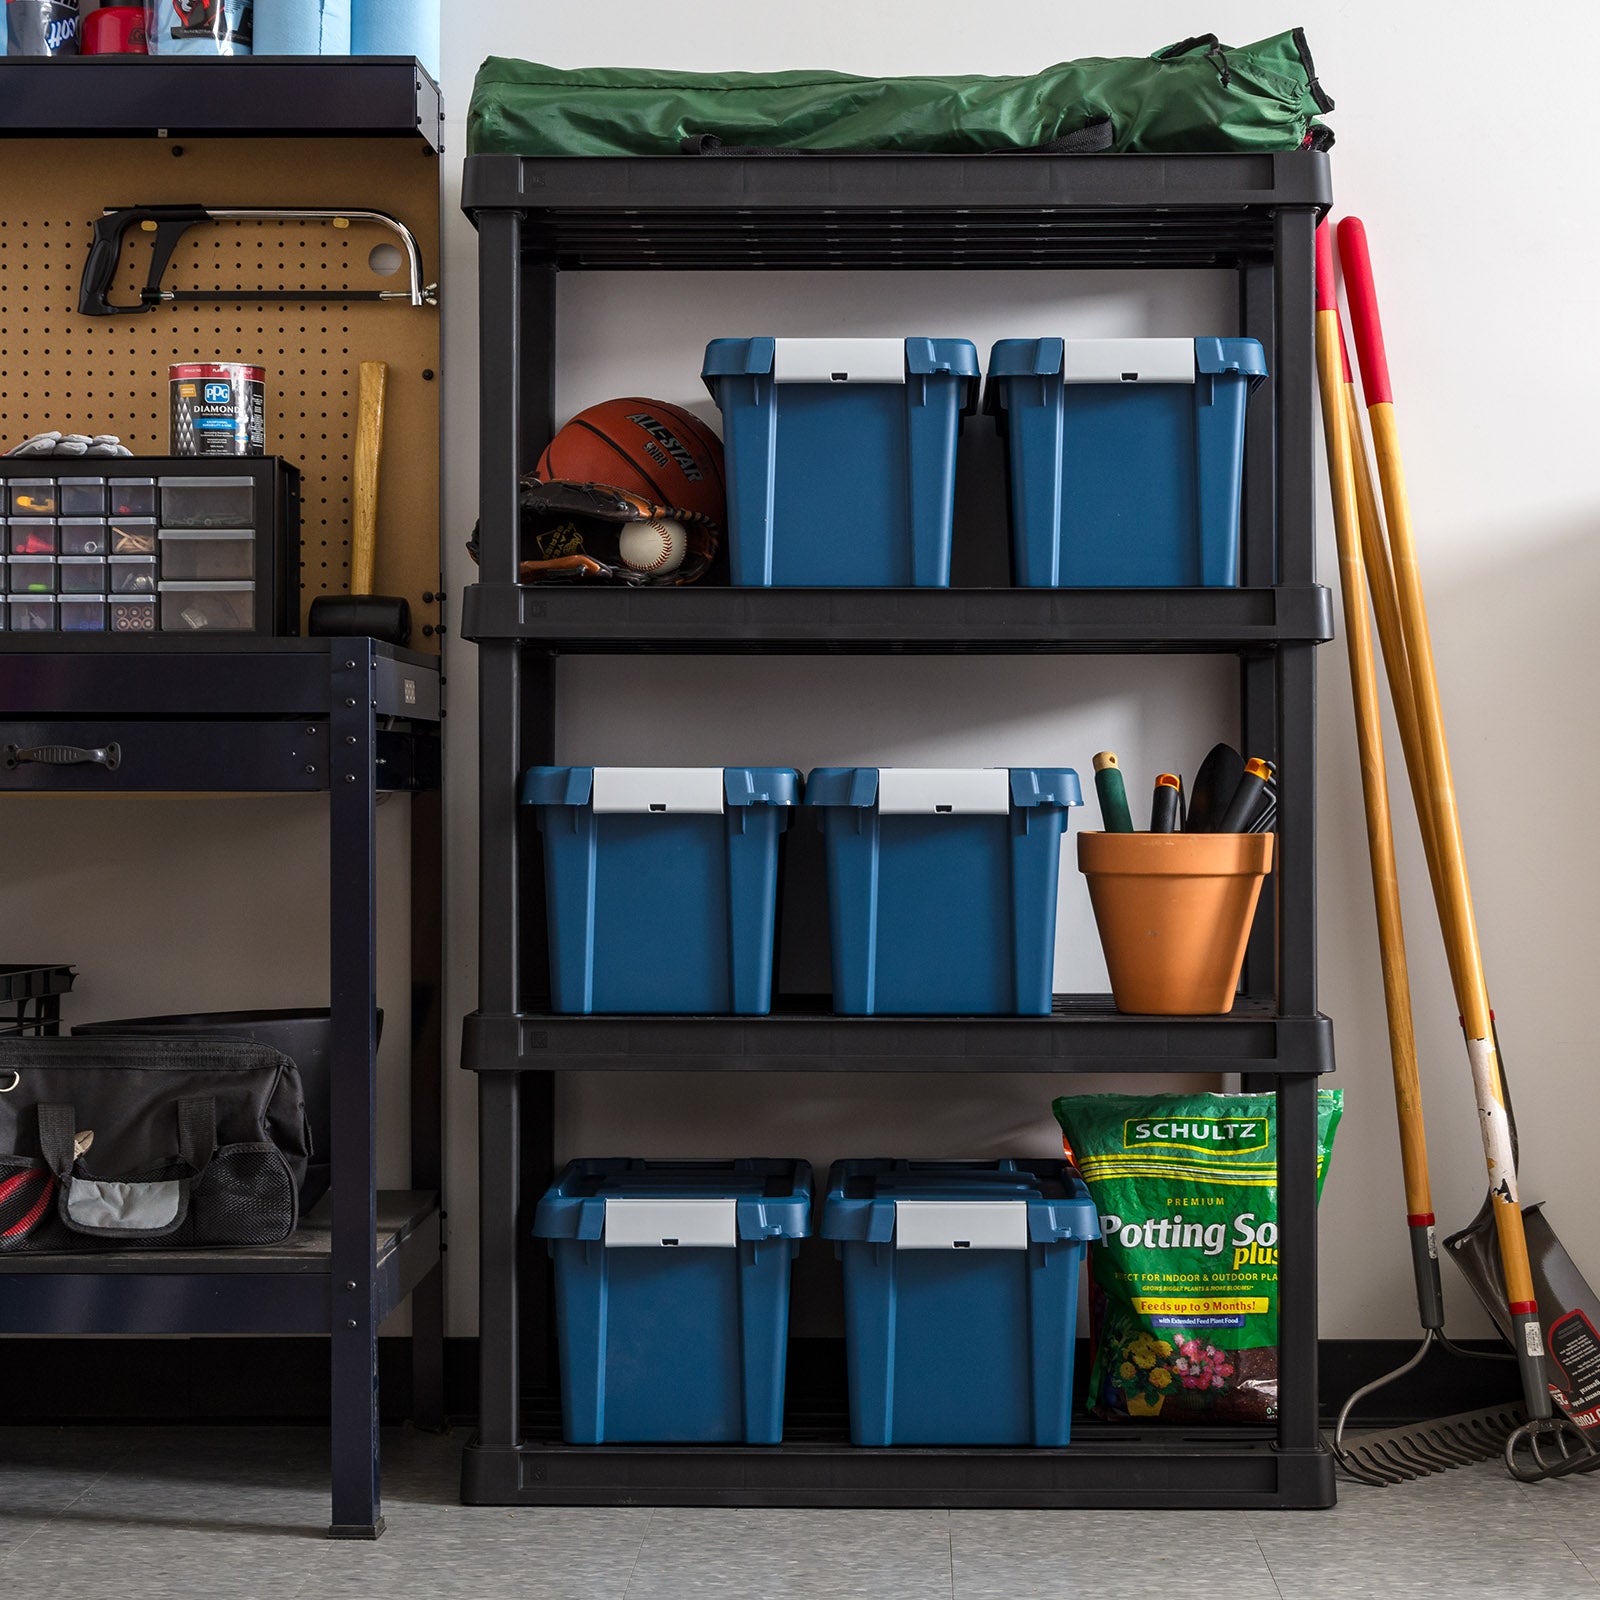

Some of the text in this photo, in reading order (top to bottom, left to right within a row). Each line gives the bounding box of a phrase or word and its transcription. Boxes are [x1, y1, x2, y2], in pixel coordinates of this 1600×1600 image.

[206, 385, 229, 401] PPG
[193, 405, 240, 413] DIAMOND
[624, 413, 704, 483] ALL-STAR
[647, 442, 670, 468] NBA
[1135, 1123, 1257, 1140] SCHULTZ
[1167, 1198, 1225, 1206] PREMIUM
[1099, 1213, 1278, 1255] Potting So
[1141, 1273, 1160, 1281] FOR
[1162, 1273, 1200, 1282] INDOOR
[1202, 1273, 1209, 1282] &
[1212, 1273, 1259, 1281] OUTDOOR
[1261, 1273, 1278, 1281] PLA
[1141, 1301, 1256, 1313] Feeds up to 9 Months!
[1171, 1317, 1197, 1325] Extended
